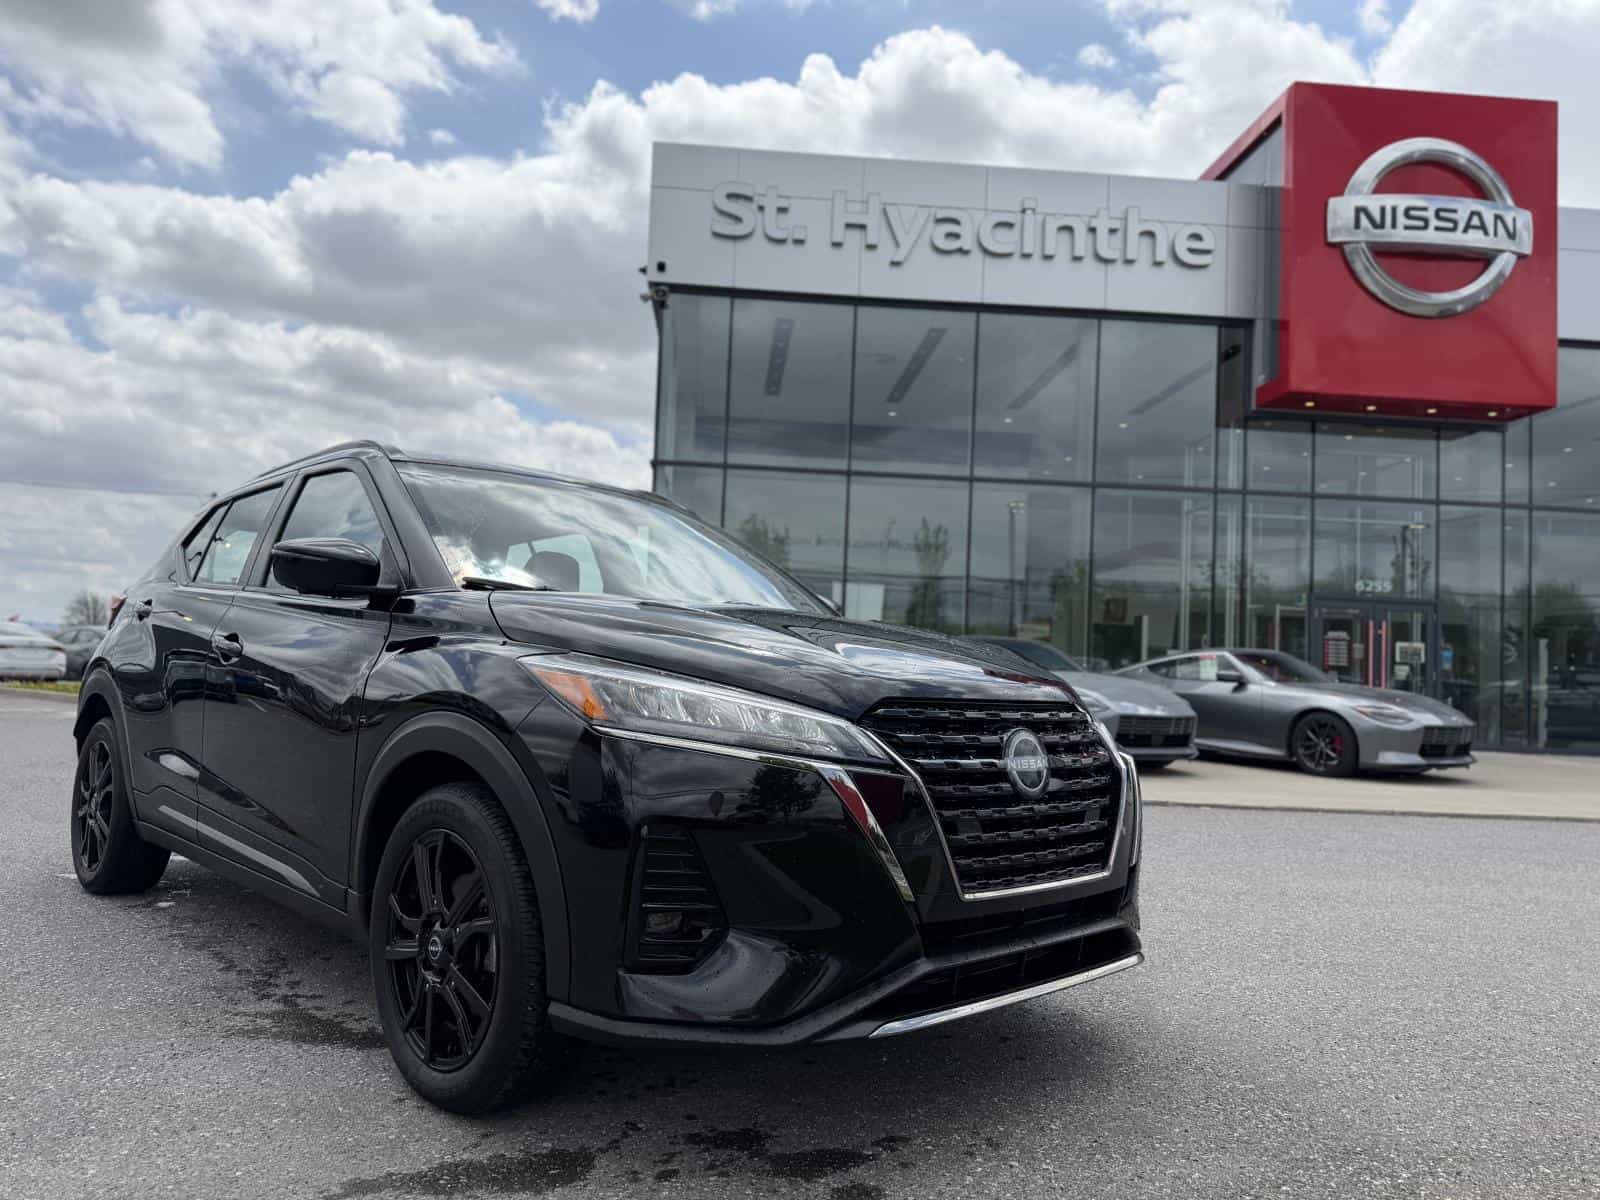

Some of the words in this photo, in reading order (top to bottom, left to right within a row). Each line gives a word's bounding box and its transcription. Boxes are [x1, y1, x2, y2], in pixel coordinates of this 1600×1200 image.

[711, 181, 807, 244] St.
[830, 190, 1216, 268] Hyacinthe
[1353, 205, 1518, 241] NISSAN
[1355, 579, 1392, 592] 6255
[1007, 758, 1049, 769] NISSAN
